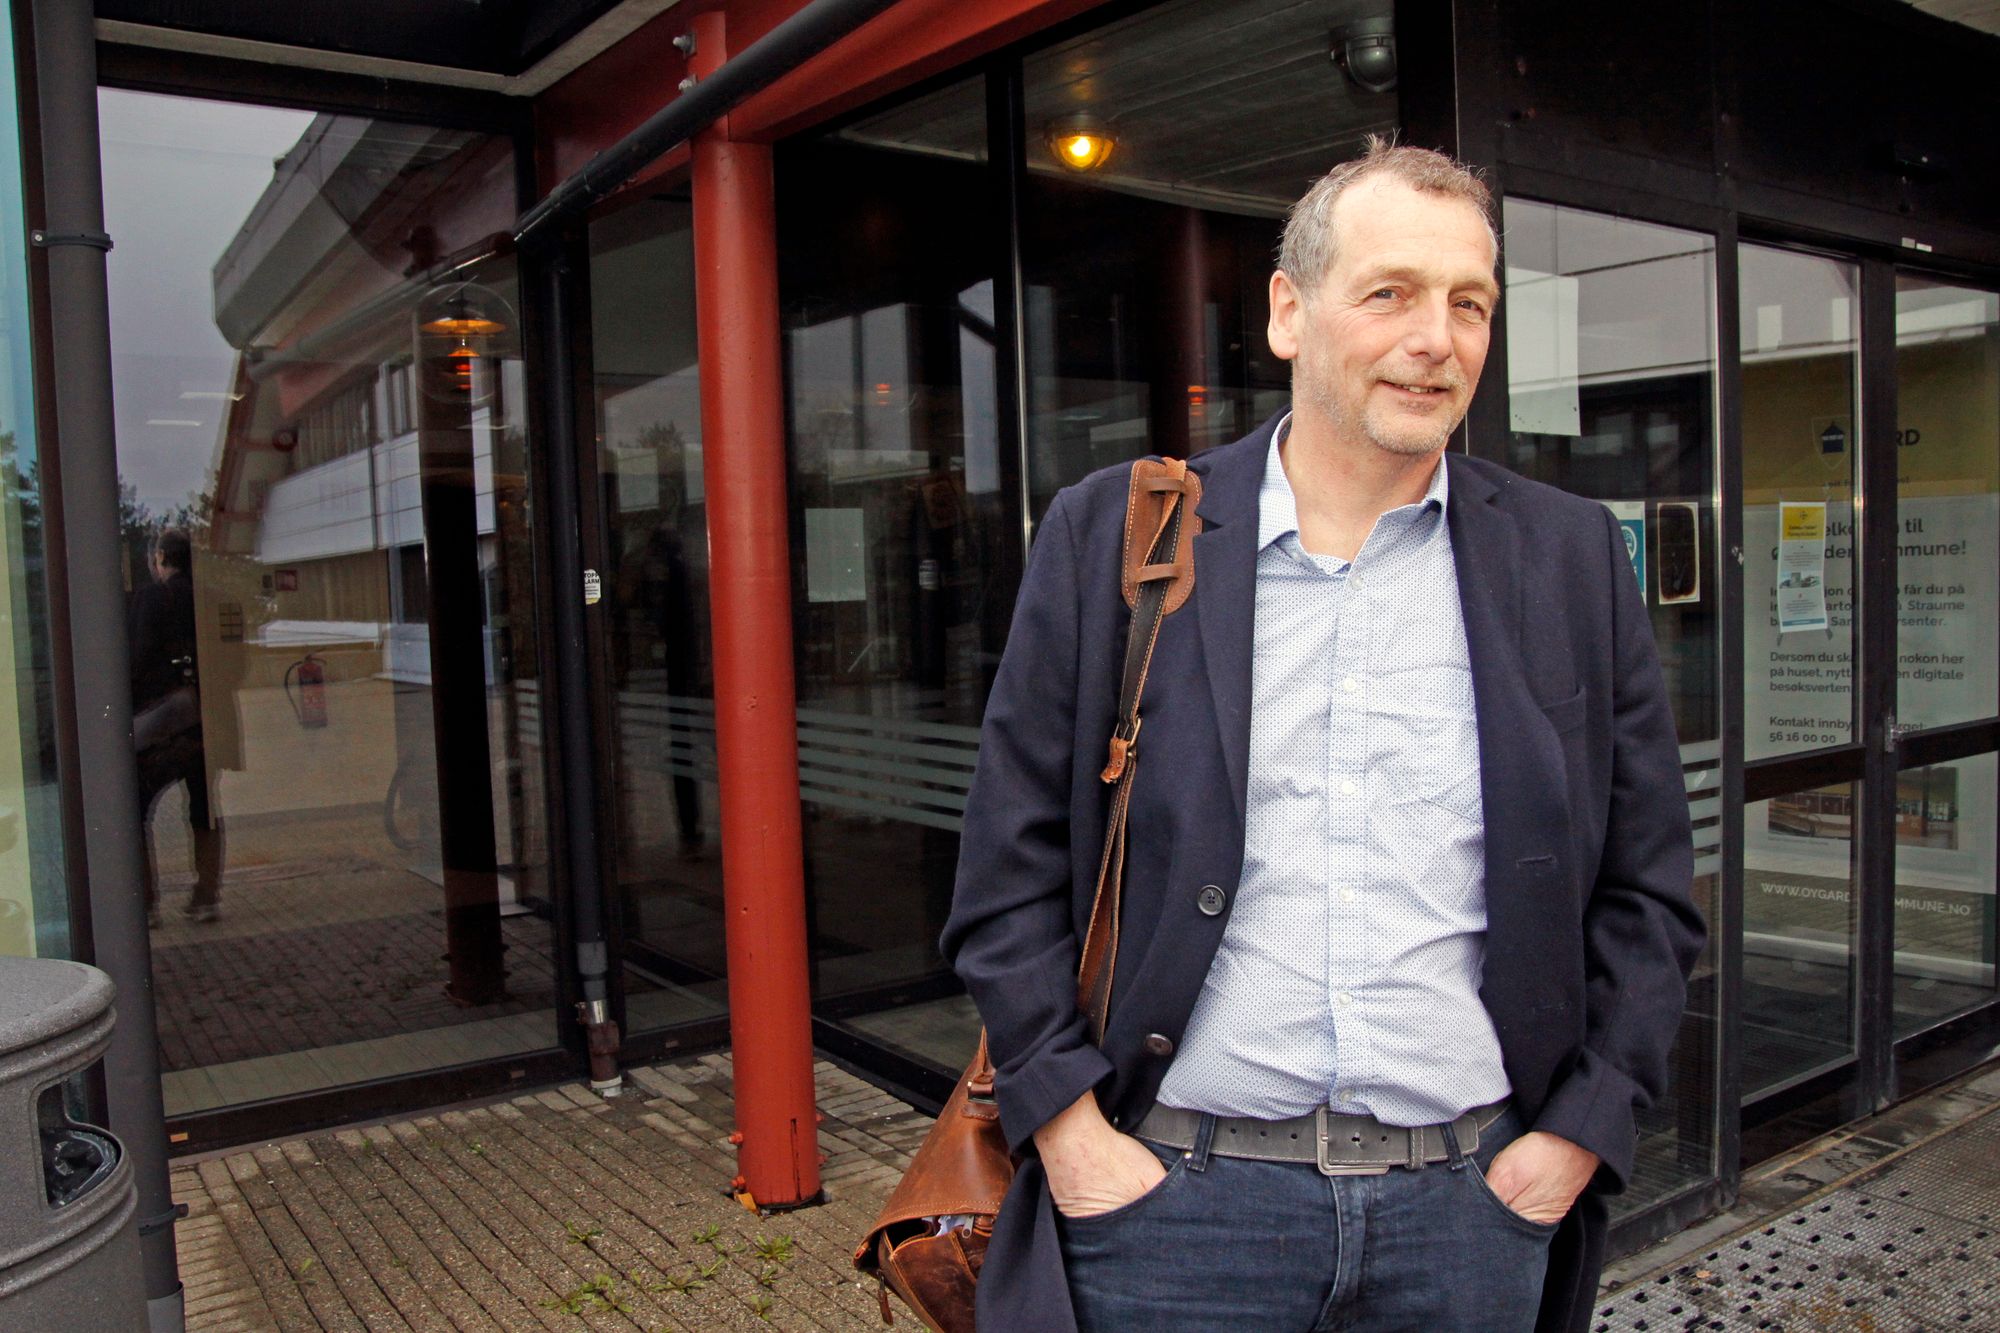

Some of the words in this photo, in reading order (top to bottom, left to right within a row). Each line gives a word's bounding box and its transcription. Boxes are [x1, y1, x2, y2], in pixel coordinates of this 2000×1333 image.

[1905, 518, 1923, 534] til
[1904, 584, 1921, 595] får
[1926, 583, 1943, 595] du
[1947, 585, 1965, 597] på
[1907, 600, 1965, 611] Straume
[1769, 651, 1816, 663] Dersom
[1818, 652, 1834, 663] du
[1900, 653, 1938, 664] nokon
[1942, 654, 1965, 664] her
[1769, 668, 1784, 680] på
[1826, 670, 1852, 682] nytt
[1913, 668, 1965, 682] digitale
[1769, 716, 1814, 728] Kontakt
[1769, 734, 1784, 742] 56
[1786, 733, 1800, 743] 16
[1802, 734, 1818, 743] 00
[1820, 735, 1837, 744] 00
